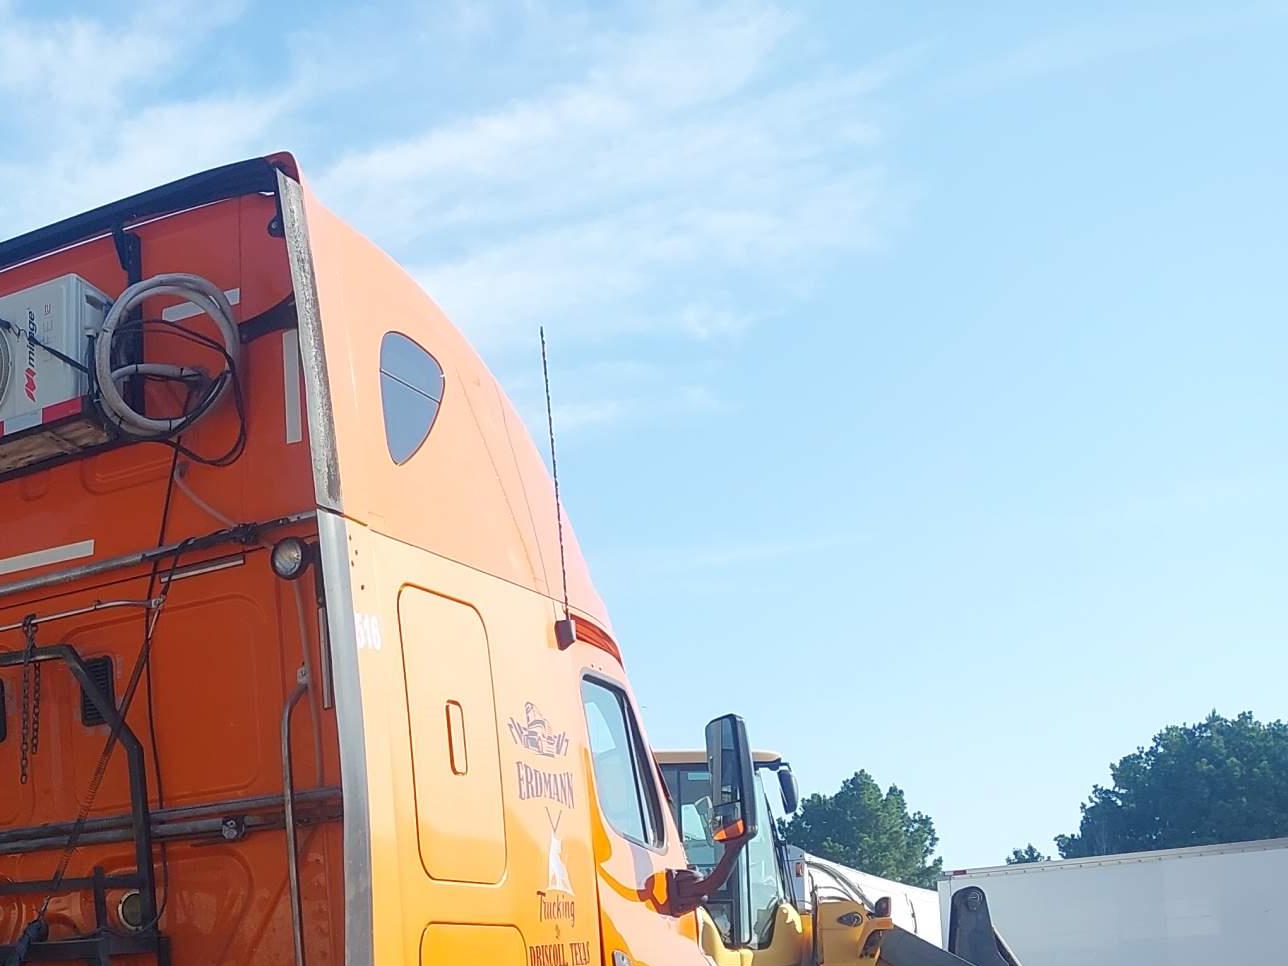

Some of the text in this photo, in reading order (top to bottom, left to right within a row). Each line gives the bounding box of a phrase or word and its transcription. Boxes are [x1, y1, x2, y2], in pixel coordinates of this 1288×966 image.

[516, 761, 574, 809] ERDMANN
[536, 890, 575, 928] Trucking
[569, 941, 591, 966] TEXAS
